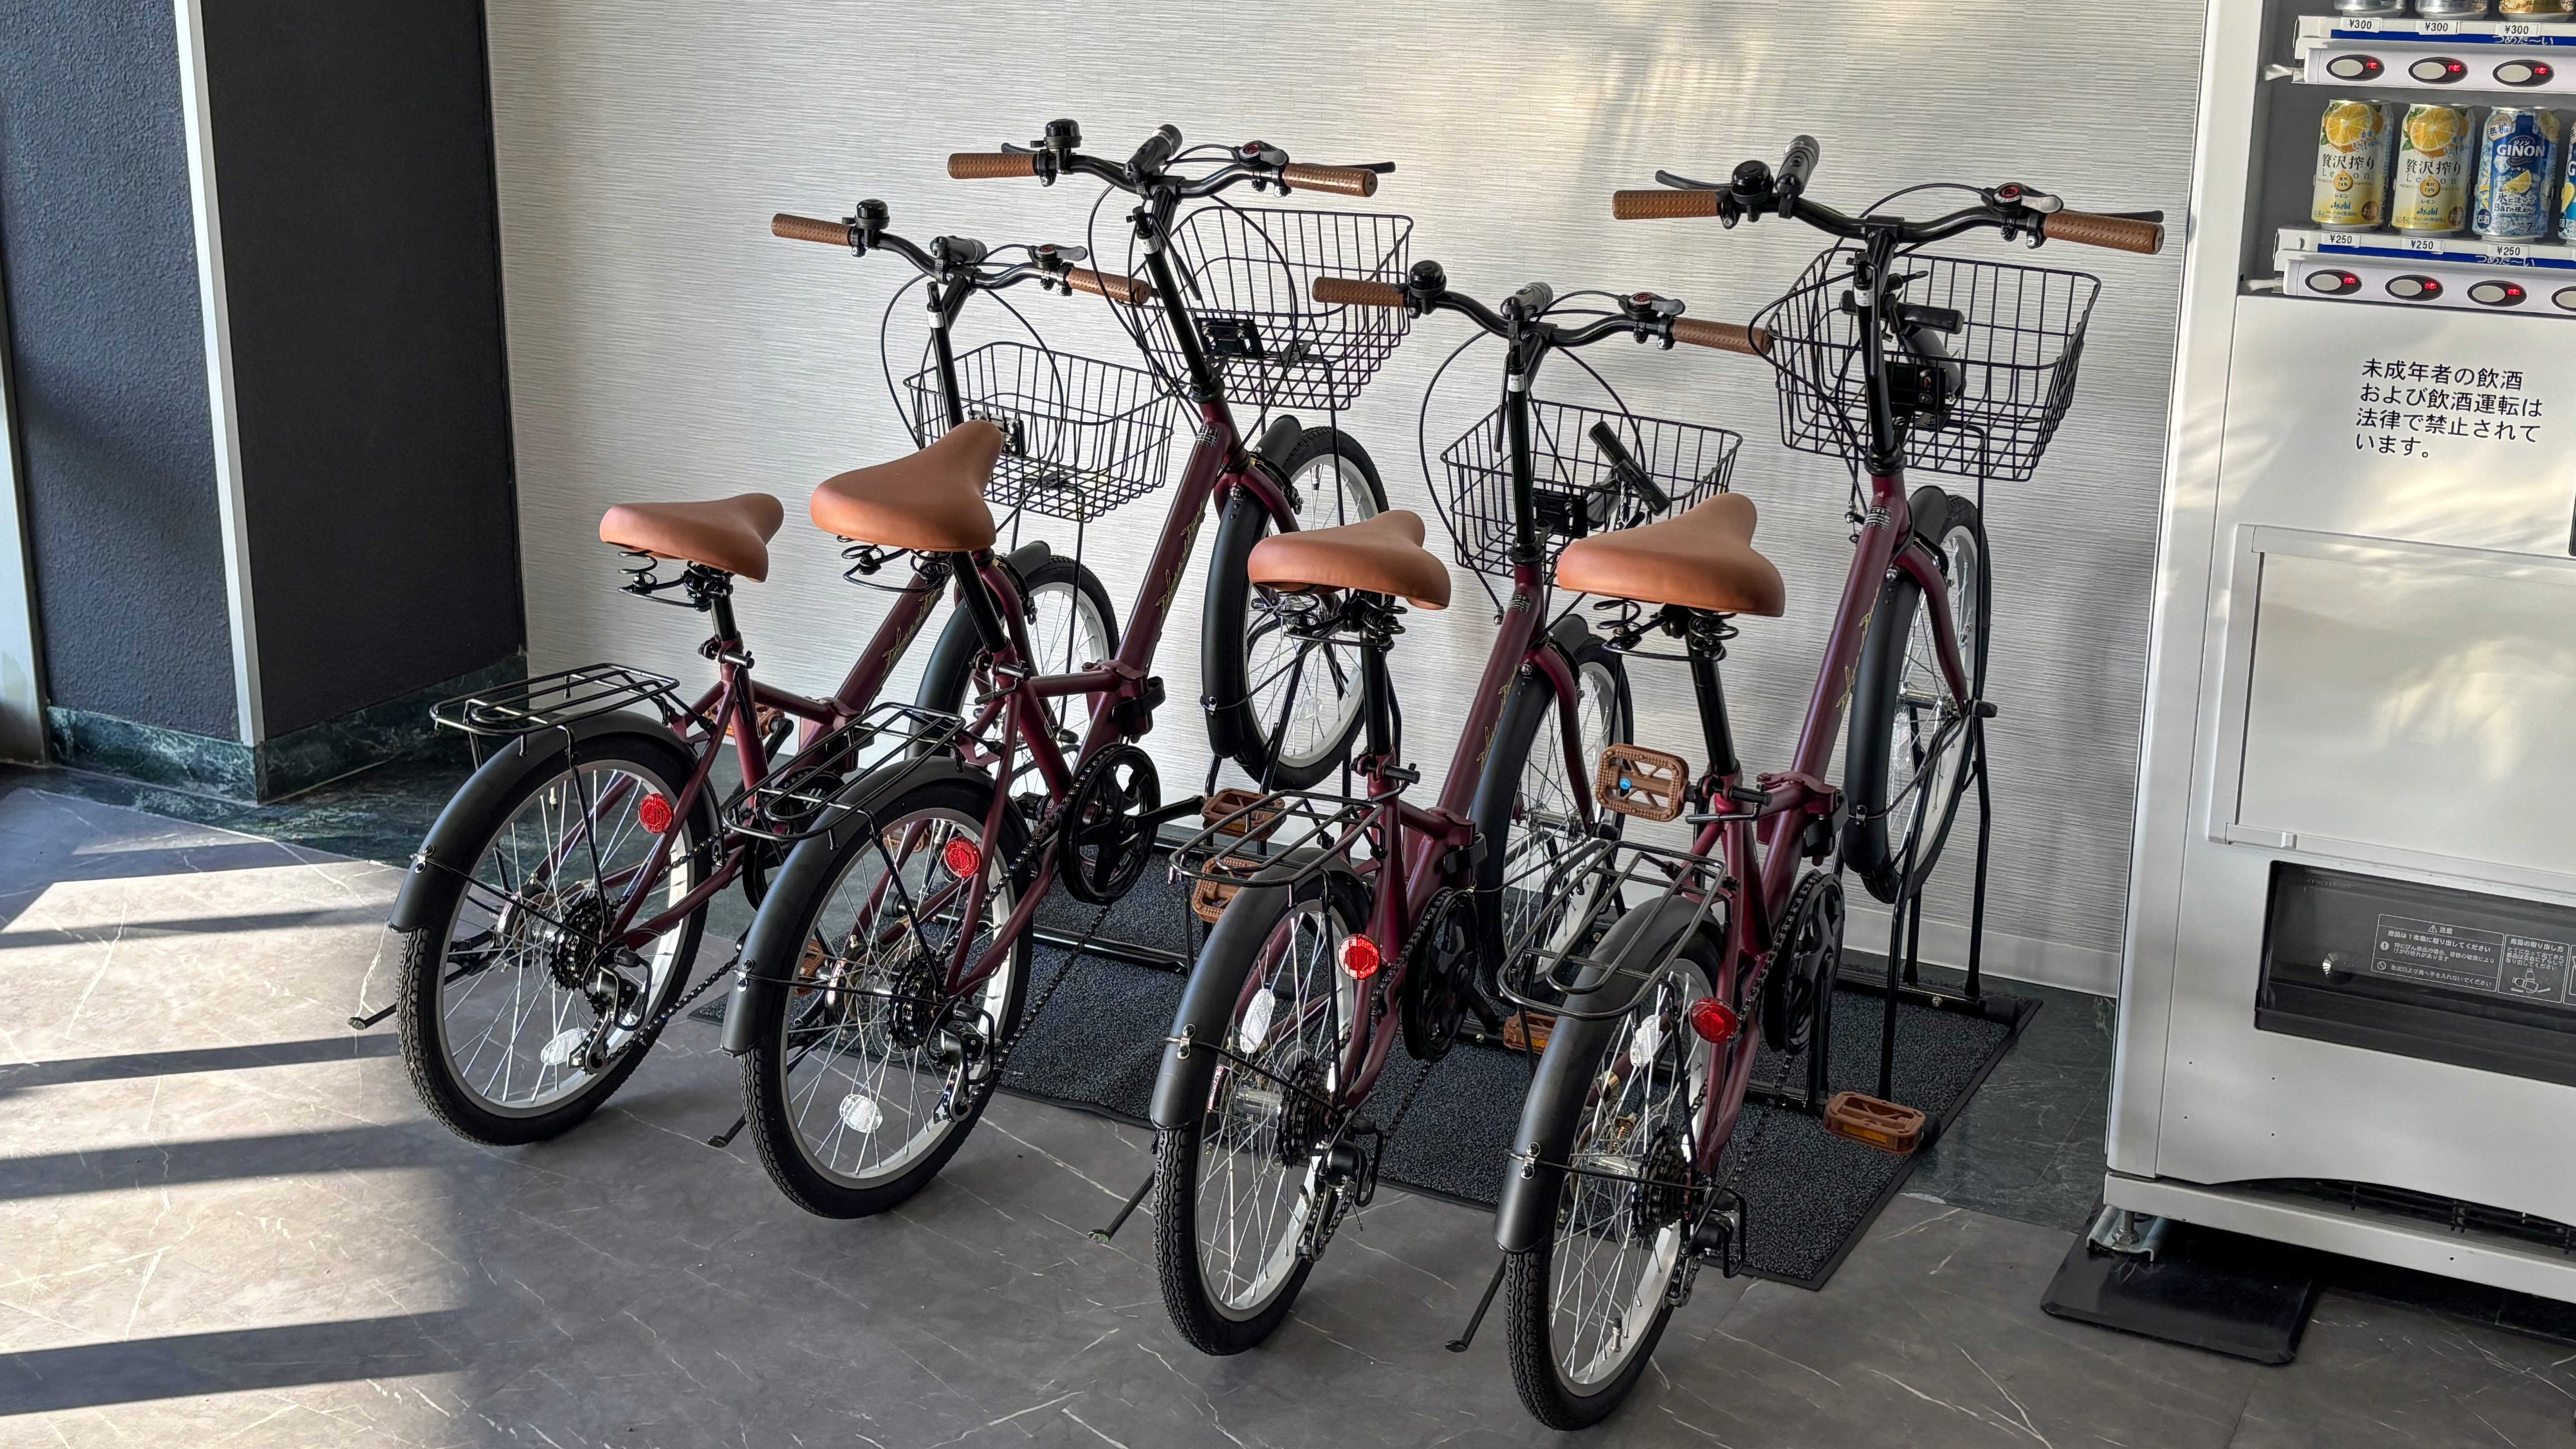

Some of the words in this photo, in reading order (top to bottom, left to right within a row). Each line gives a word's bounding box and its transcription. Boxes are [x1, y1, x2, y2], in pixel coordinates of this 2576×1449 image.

[2349, 19, 2372, 29] ¥300
[2425, 22, 2448, 32] ¥300
[2504, 25, 2529, 34] ¥300
[2497, 144, 2545, 157] GINON
[2478, 215, 2490, 225] お酒
[2330, 234, 2352, 244] ¥250
[2411, 239, 2433, 249] ¥250
[2497, 246, 2521, 256] ¥250
[2362, 358, 2523, 391] 未成年者の飲酒
[2360, 382, 2543, 417] および飲酒運転は
[2355, 407, 2541, 443] 法律で禁止されて
[2355, 433, 2429, 458] います。
